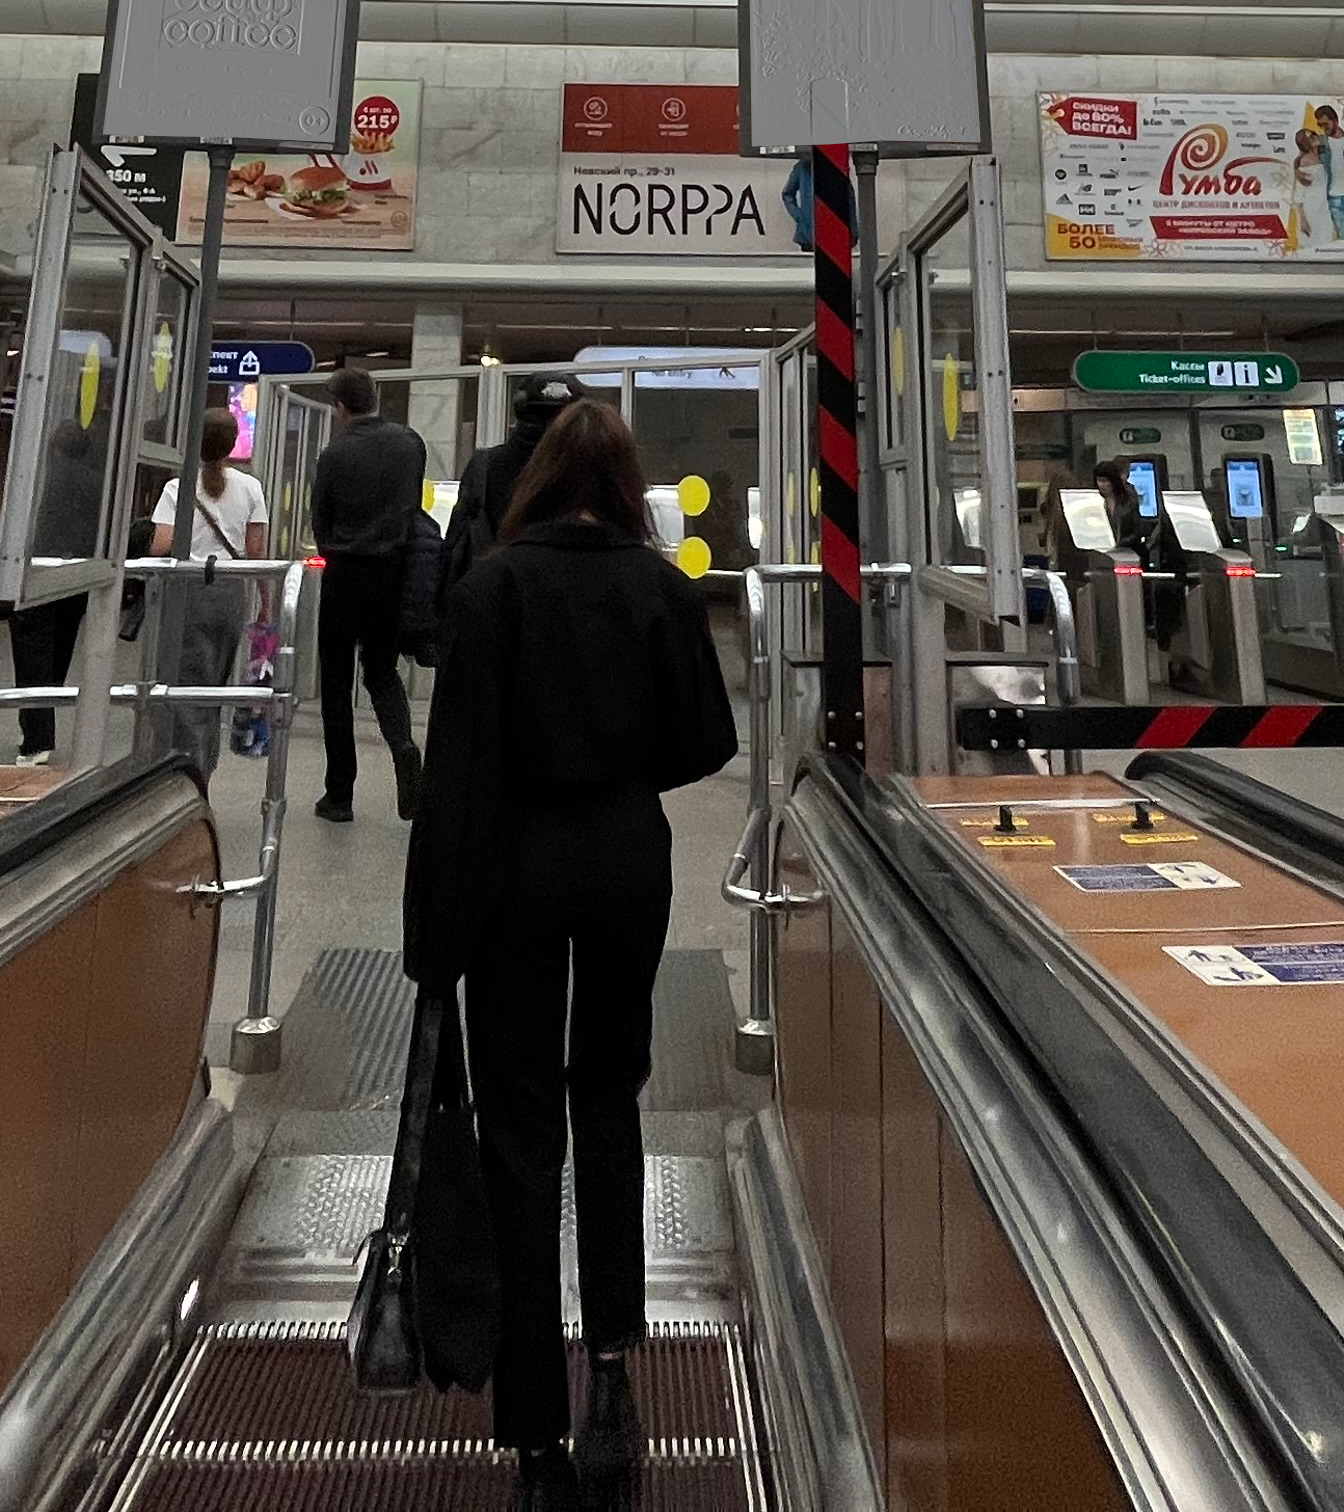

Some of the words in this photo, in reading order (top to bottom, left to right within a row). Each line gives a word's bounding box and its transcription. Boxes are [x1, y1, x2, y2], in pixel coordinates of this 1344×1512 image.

[163, 13, 297, 50] coffee
[1072, 101, 1119, 113] СКИДКИ
[1091, 111, 1125, 124] 80%
[1072, 120, 1132, 136] ВСЕГДА!
[573, 166, 621, 176] Невский
[646, 167, 676, 177] 29-31
[573, 182, 766, 236] NORPPA
[1057, 222, 1115, 235] БОЛЕЕ
[1170, 360, 1205, 371] Кассы
[1138, 373, 1206, 384] Ticket-offices
